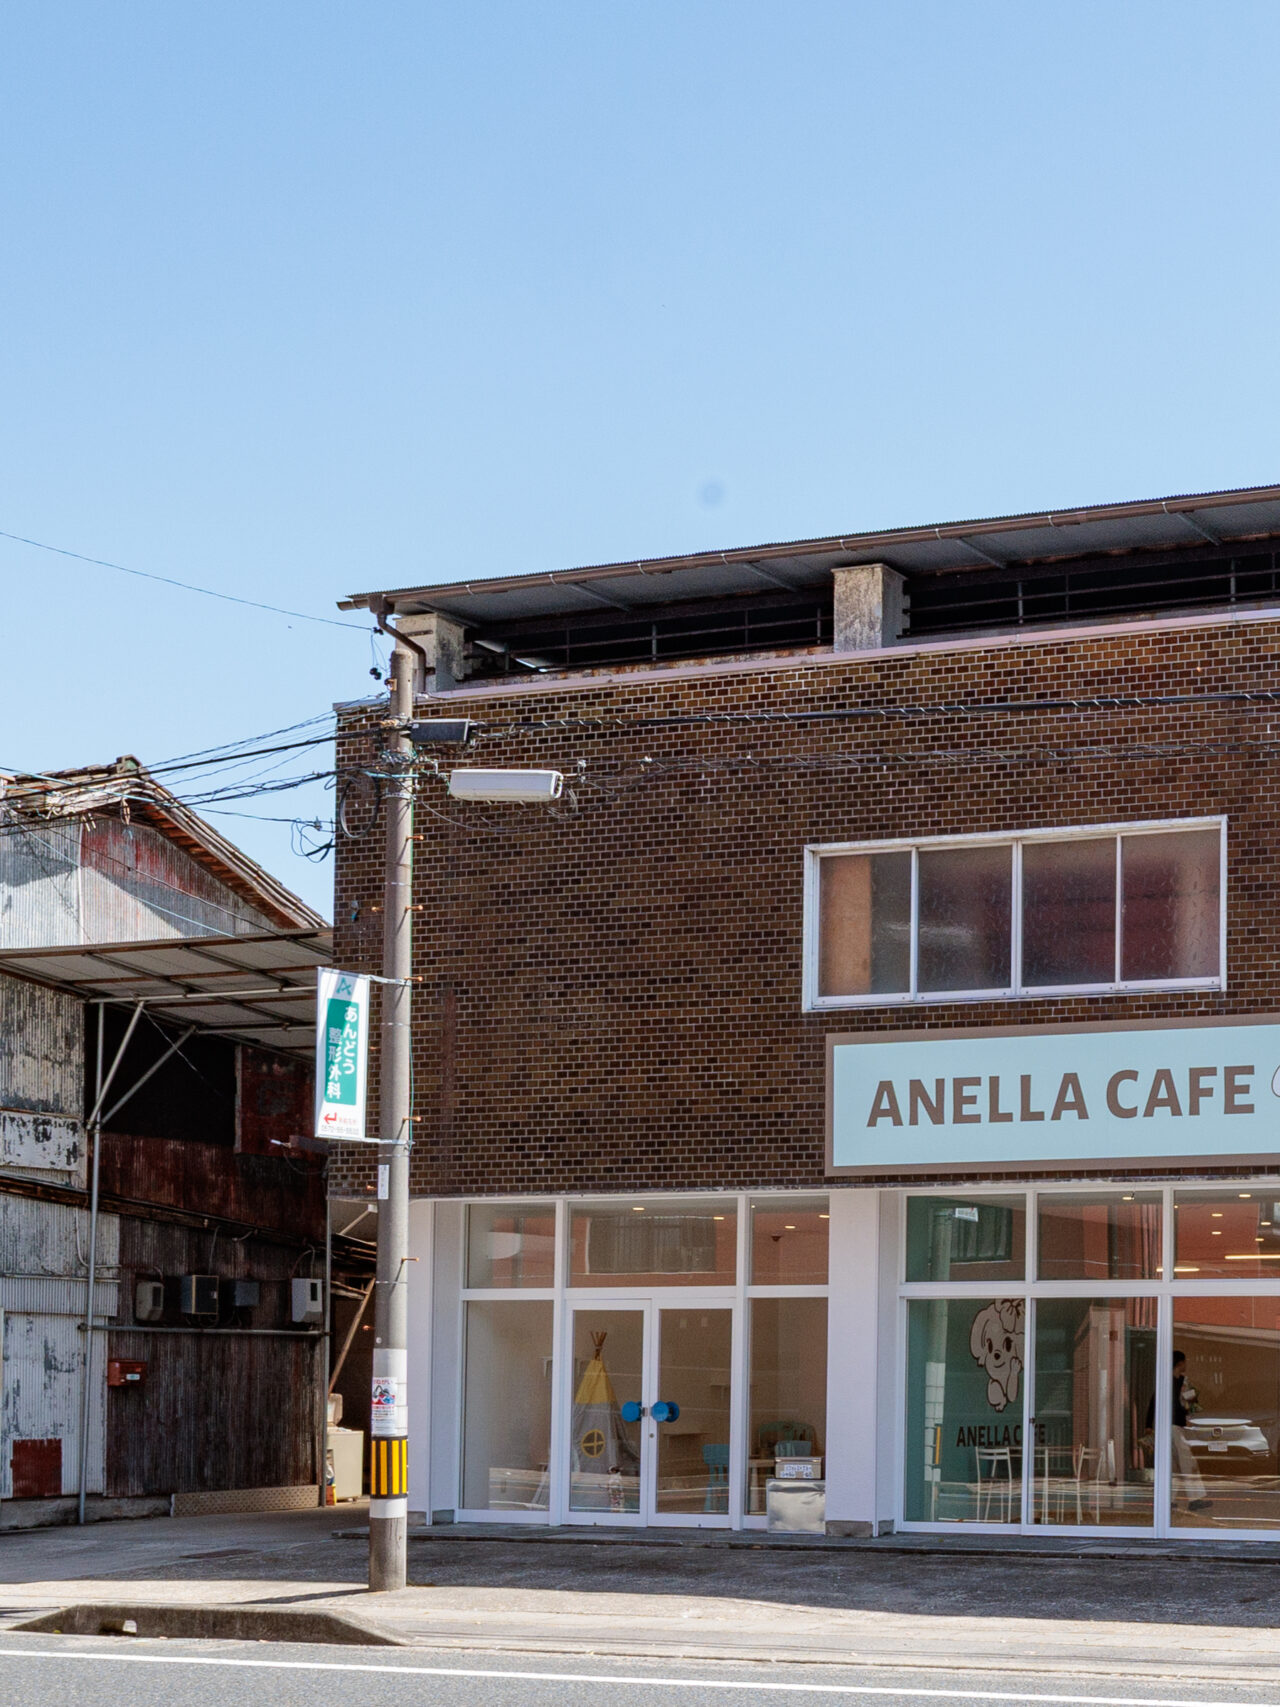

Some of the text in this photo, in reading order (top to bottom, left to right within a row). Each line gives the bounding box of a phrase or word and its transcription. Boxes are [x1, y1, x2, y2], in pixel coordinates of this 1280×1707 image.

[327, 1027, 342, 1099] 整形外科
[343, 1006, 358, 1074] あんどう
[866, 1065, 1255, 1128] ANELLA CAFE
[956, 1425, 1010, 1447] ANELLA
